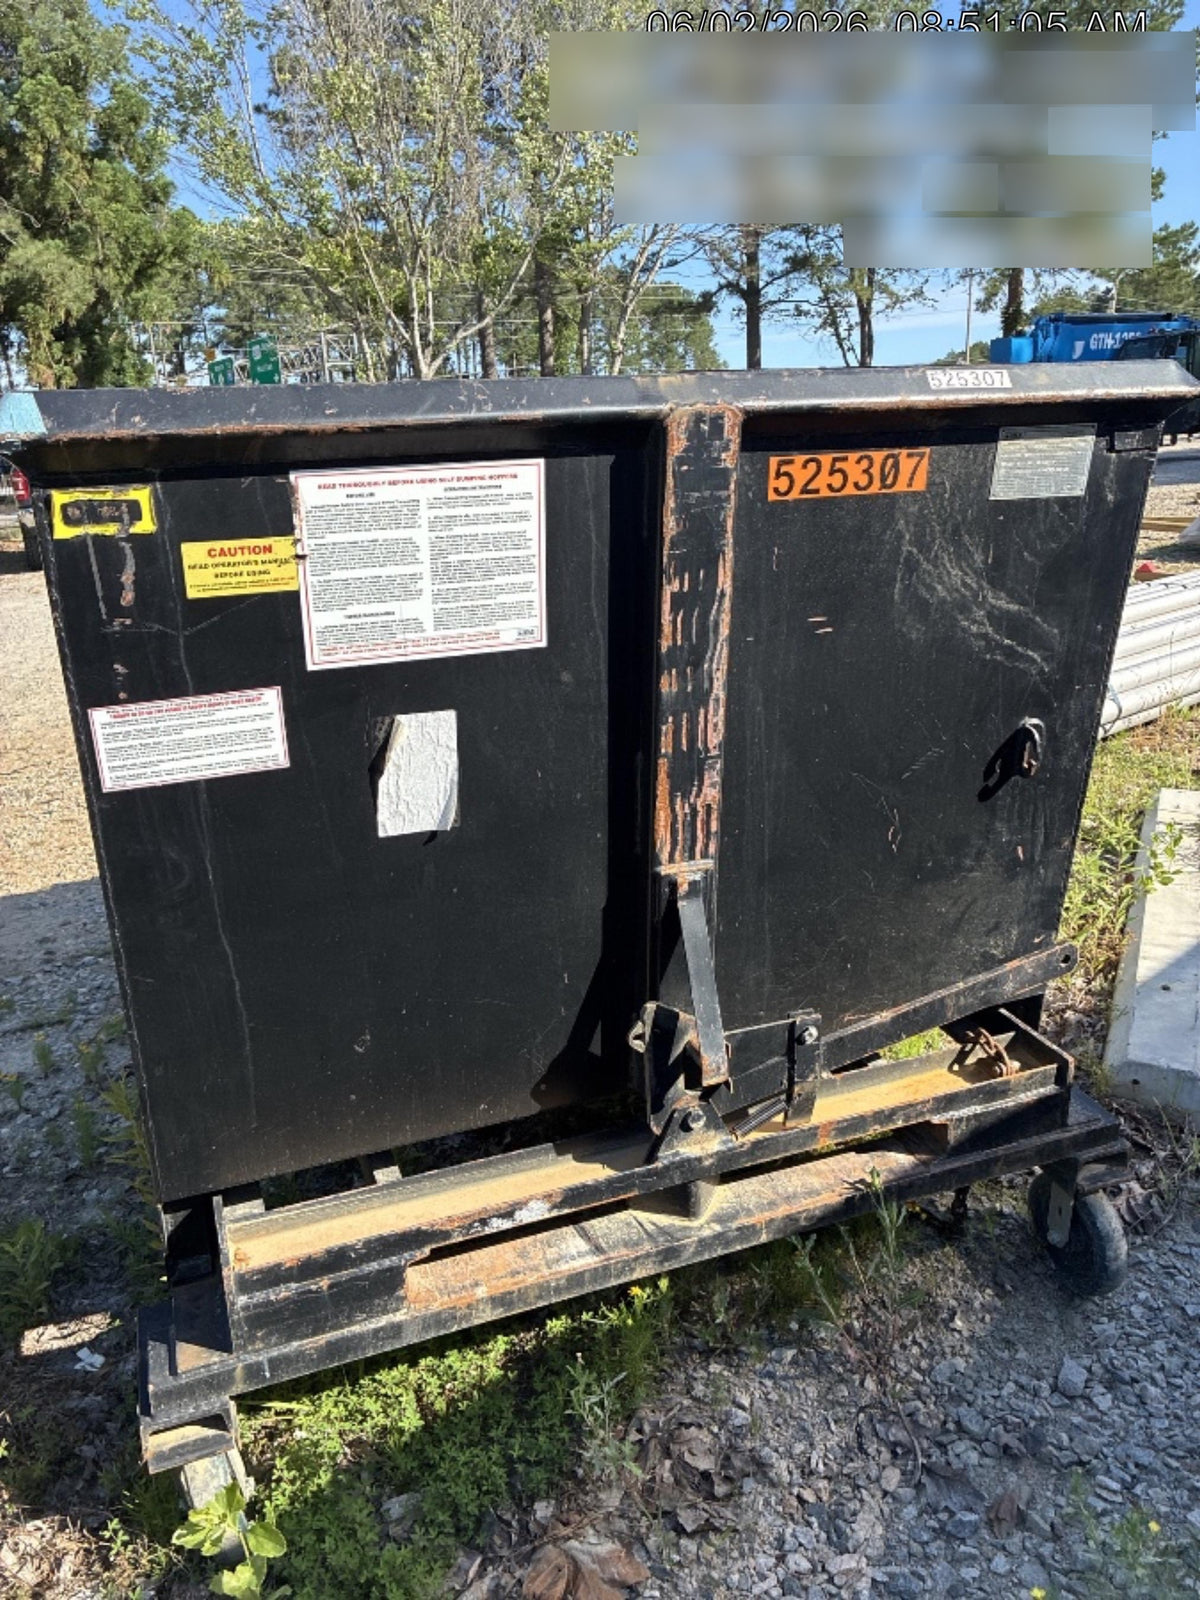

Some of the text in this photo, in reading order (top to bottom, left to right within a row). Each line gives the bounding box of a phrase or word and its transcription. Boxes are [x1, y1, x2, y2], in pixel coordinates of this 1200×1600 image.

[930, 371, 1003, 387] 525307
[773, 451, 926, 497] 525307
[207, 544, 273, 558] CAUTION
